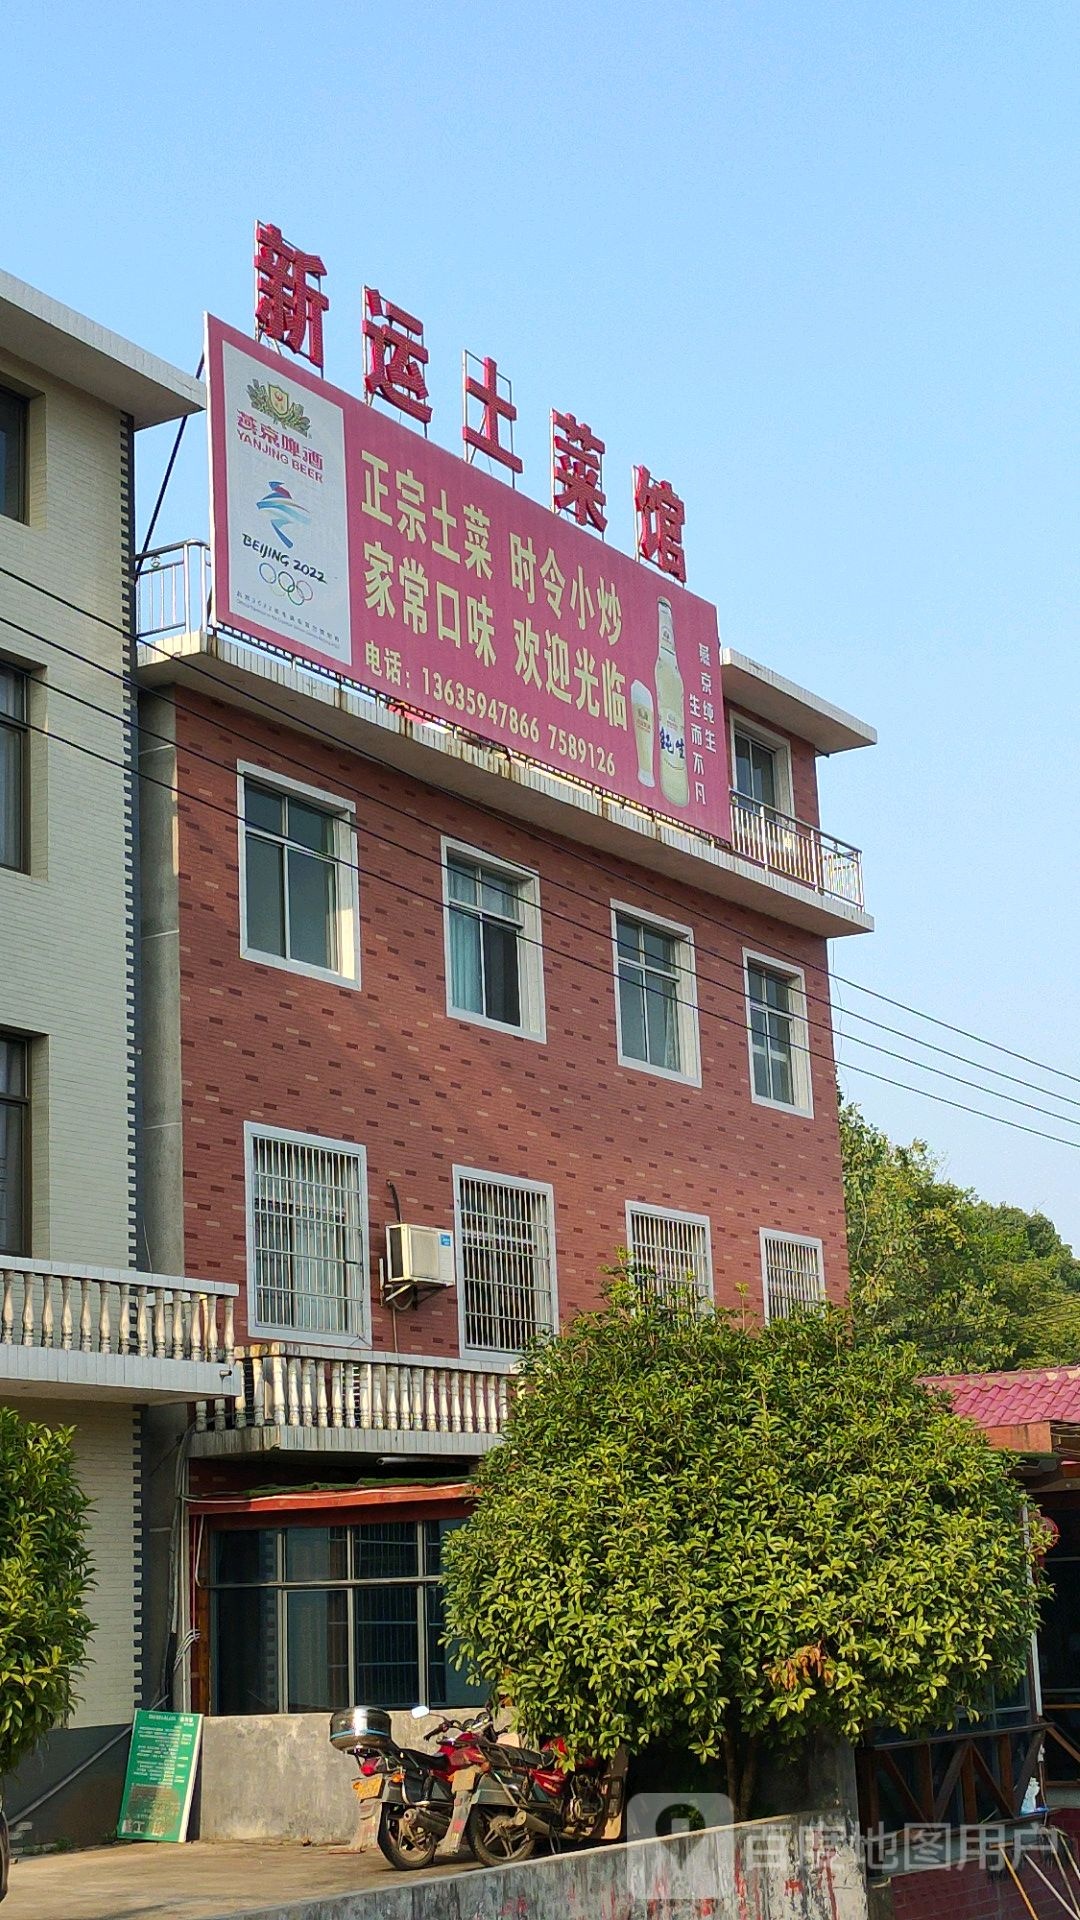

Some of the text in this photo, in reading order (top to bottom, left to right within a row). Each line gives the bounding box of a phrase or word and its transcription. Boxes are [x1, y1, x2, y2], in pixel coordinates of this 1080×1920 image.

[237, 408, 323, 471] 燕京啤酒
[237, 429, 323, 484] YANJING BEER
[254, 223, 688, 583] 新运土菜馆
[242, 532, 327, 584] BEIJING 2022
[361, 449, 622, 645] 正宗土菜 时令小炒
[364, 540, 497, 667] 家常口味
[512, 617, 628, 731] 欢迎光临
[422, 667, 540, 743] 13635947866
[548, 724, 616, 777] 7589126
[689, 693, 707, 805] 生而不凡
